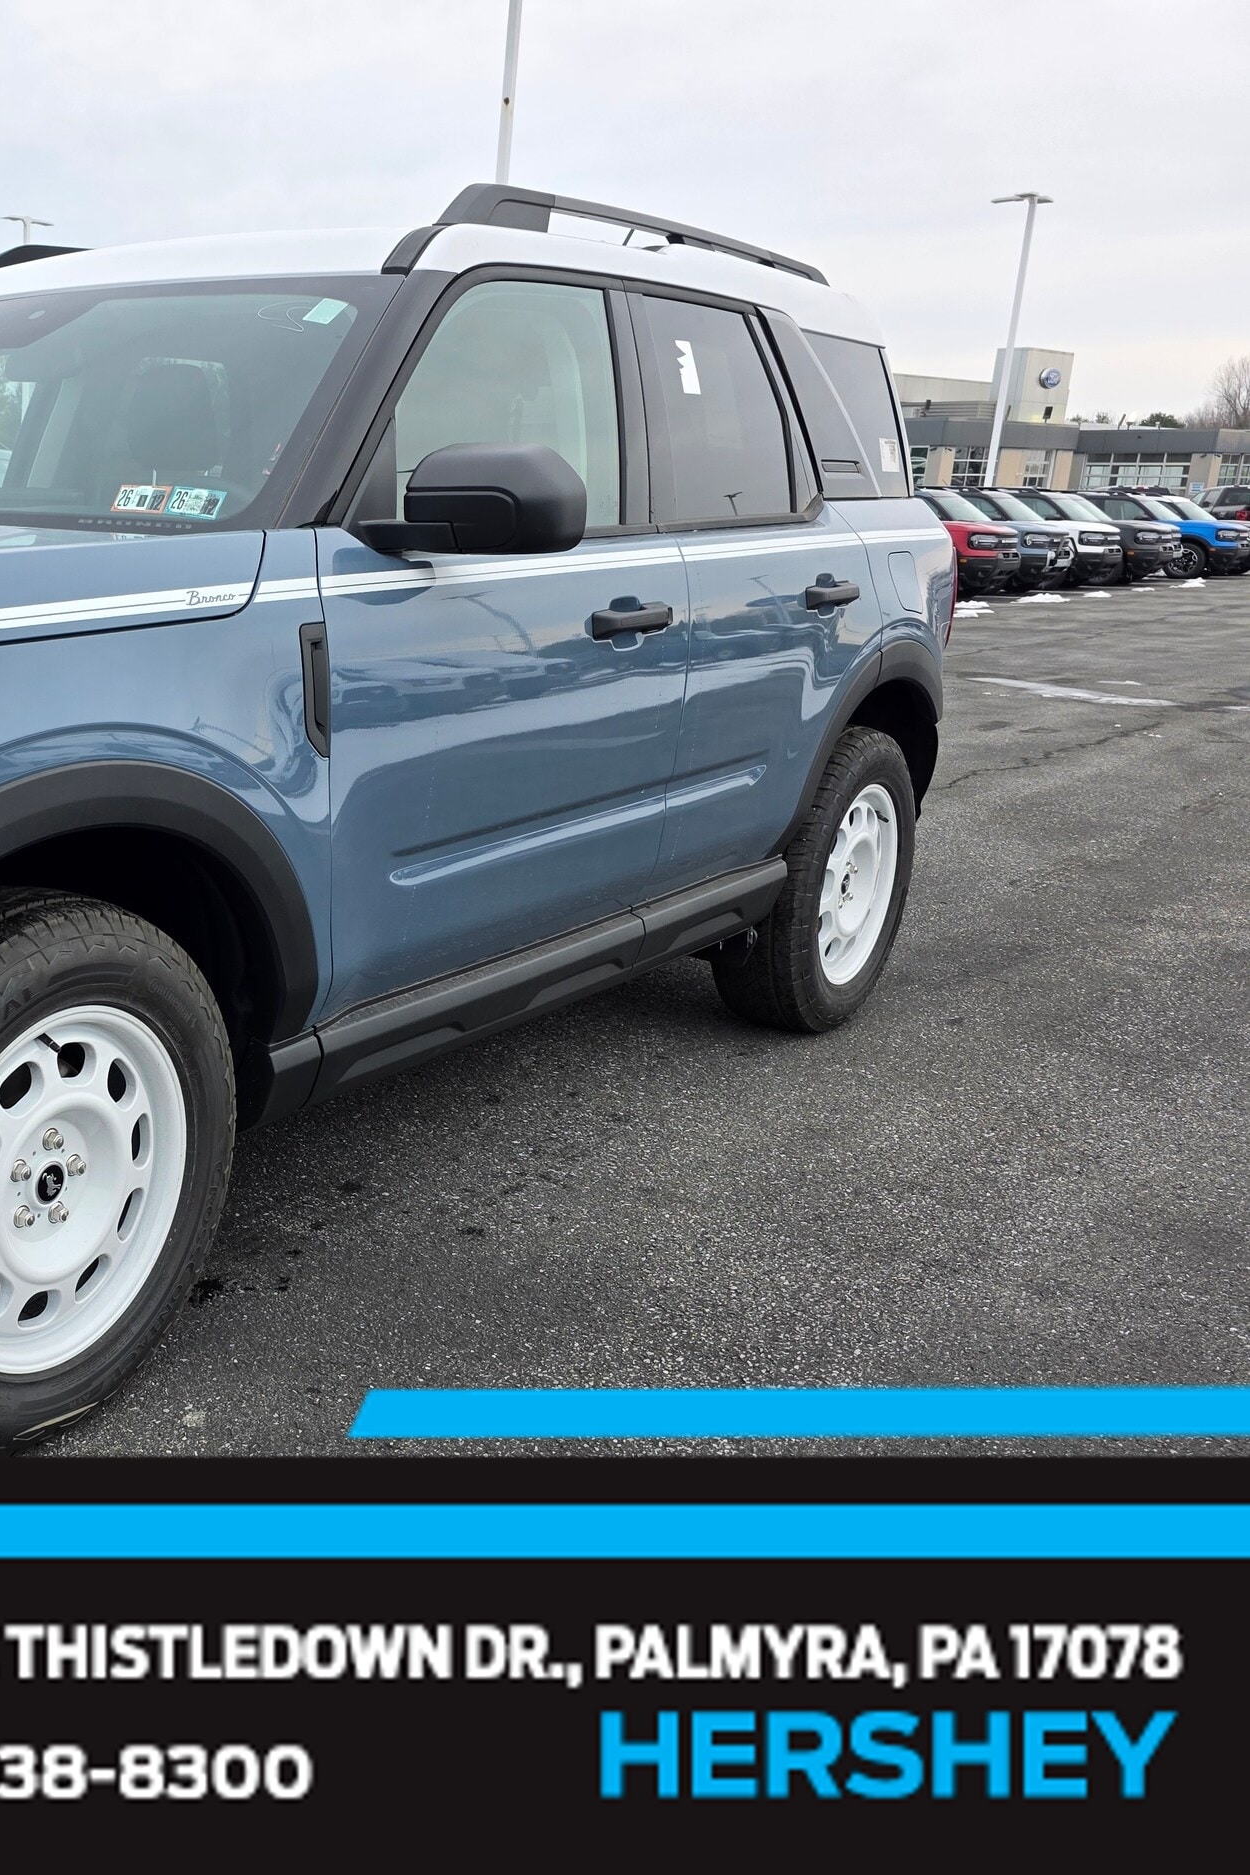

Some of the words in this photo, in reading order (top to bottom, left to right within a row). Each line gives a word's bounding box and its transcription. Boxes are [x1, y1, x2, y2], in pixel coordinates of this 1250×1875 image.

[116, 489, 134, 507] 26
[148, 494, 165, 511] 12
[170, 491, 189, 509] 26
[186, 590, 236, 605] Bronco
